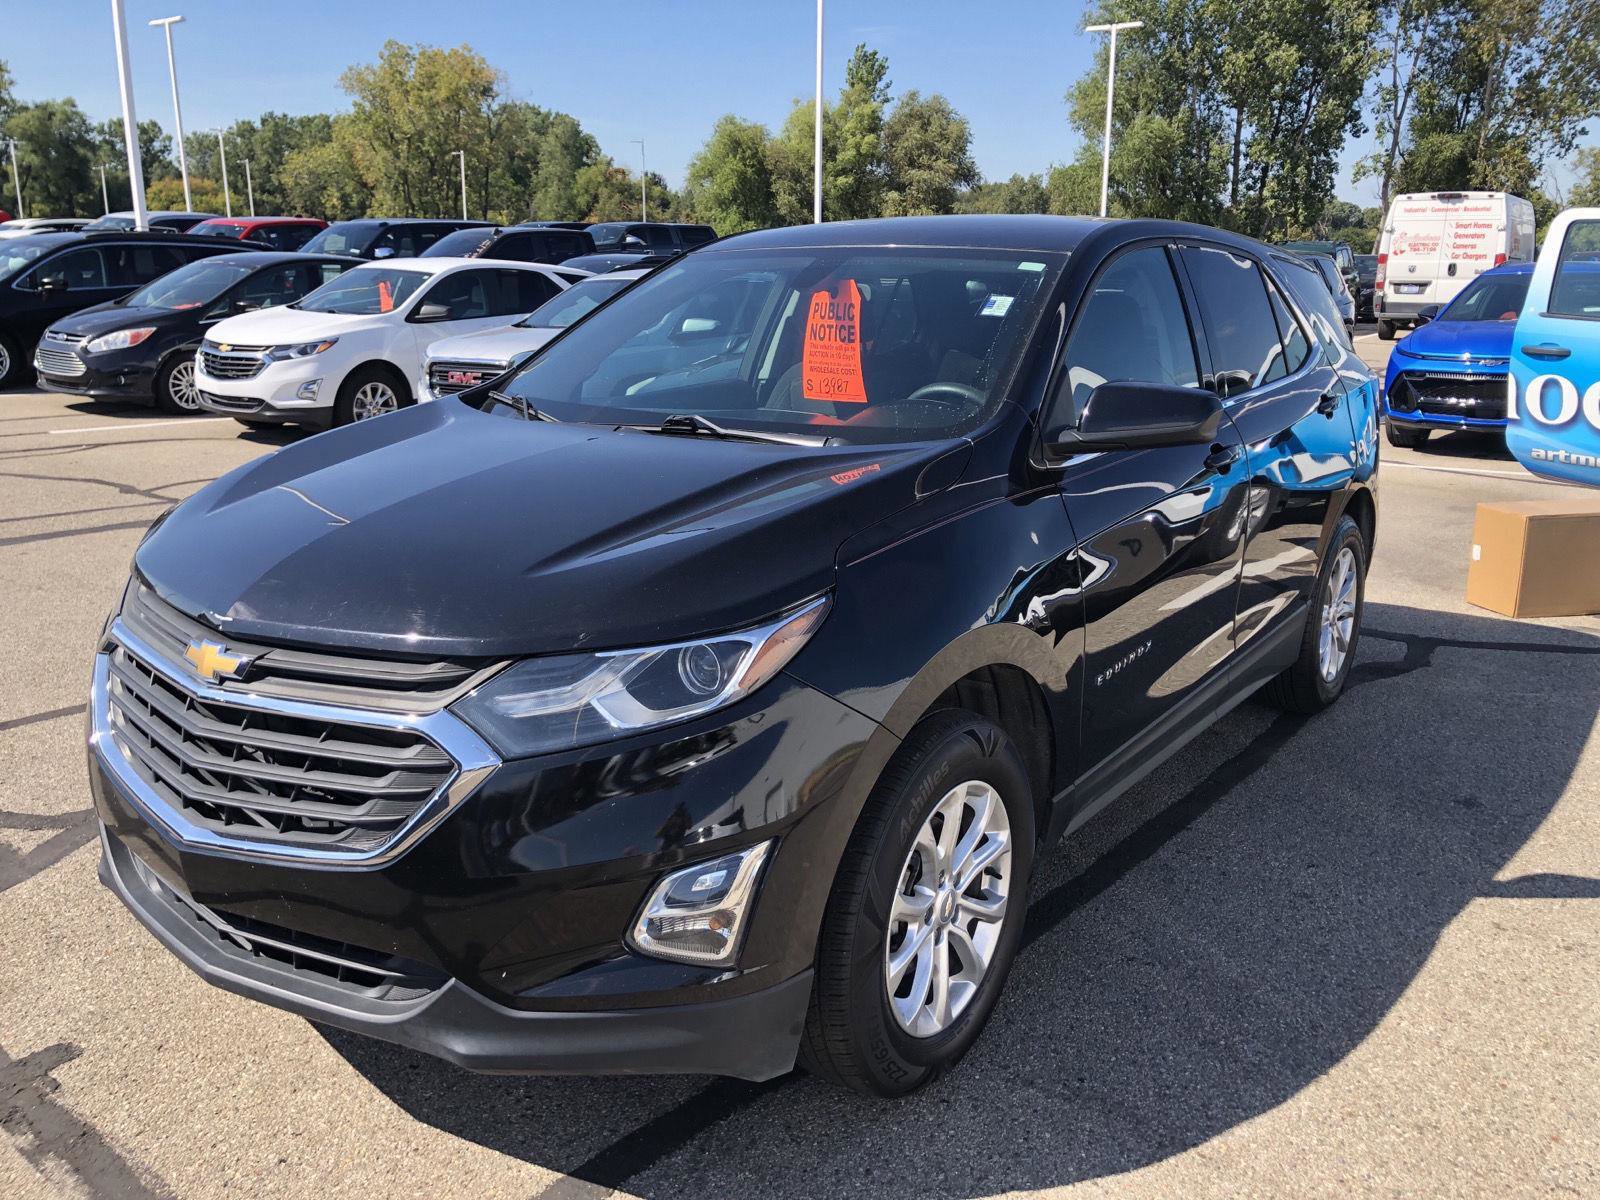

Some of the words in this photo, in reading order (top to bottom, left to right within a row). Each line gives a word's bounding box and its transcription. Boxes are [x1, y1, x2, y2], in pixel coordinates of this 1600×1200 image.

[1462, 252, 1487, 261] Chargers
[812, 302, 856, 321] PUBLIC
[809, 322, 856, 344] NOTICE
[447, 371, 482, 385] GMC
[809, 365, 840, 375] WHOLESALE
[1531, 448, 1600, 467] artm
[1096, 640, 1152, 687] EQUINOX
[898, 760, 951, 846] Achilles
